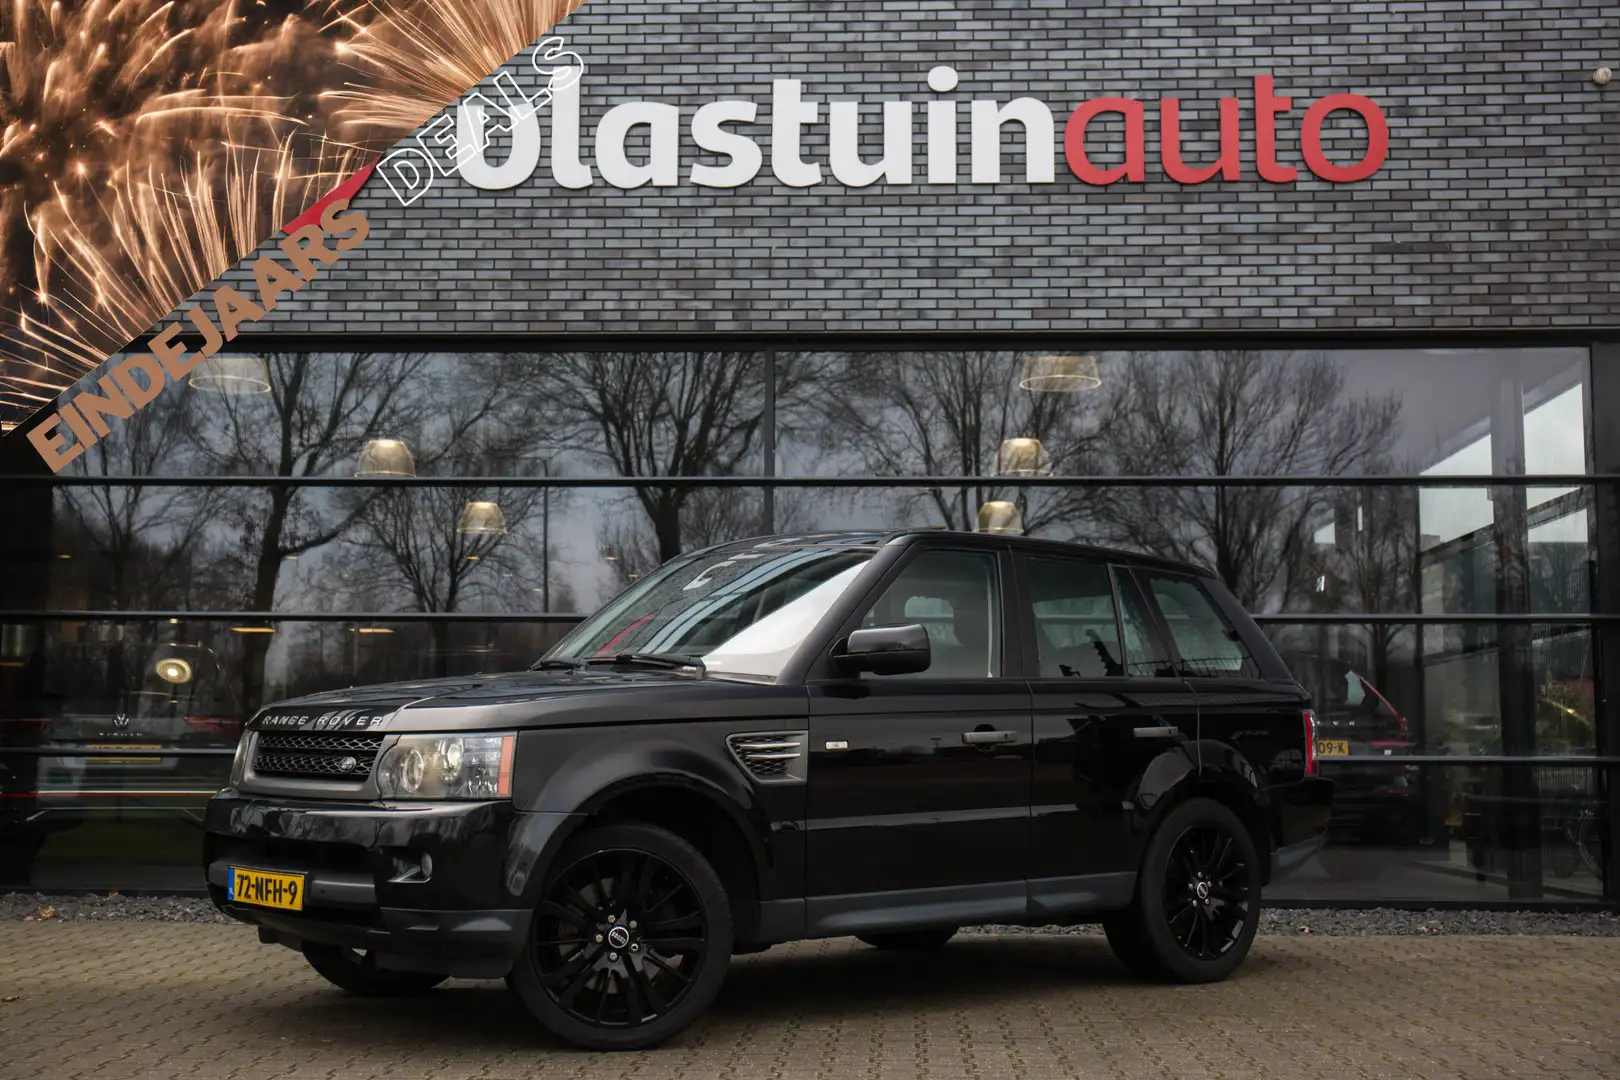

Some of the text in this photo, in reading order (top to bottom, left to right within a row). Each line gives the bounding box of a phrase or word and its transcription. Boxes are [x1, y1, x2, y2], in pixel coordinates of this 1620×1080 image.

[262, 715, 384, 726] RANGE ROVER
[237, 873, 298, 905] 72-NFH-9
